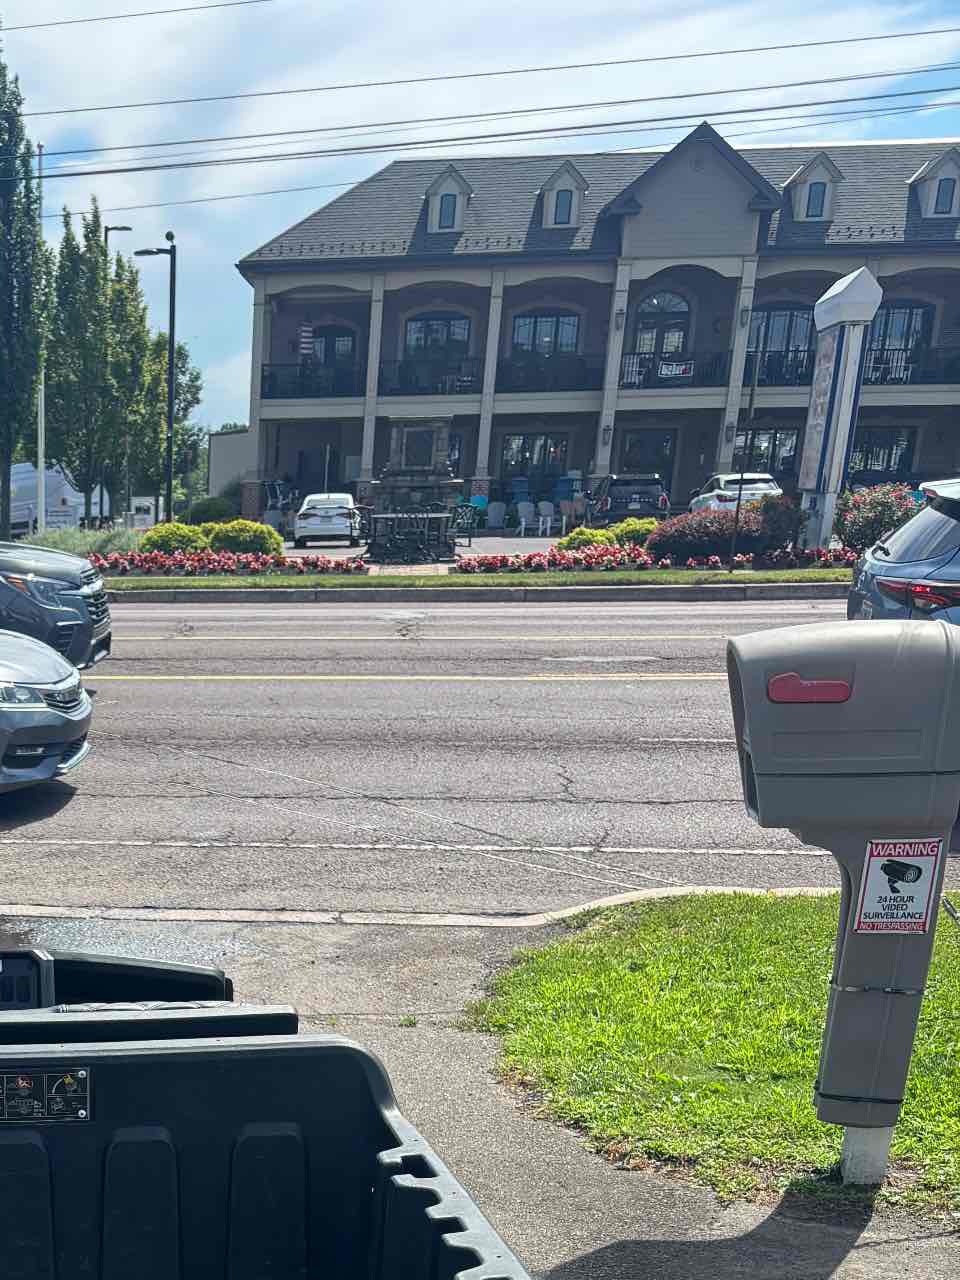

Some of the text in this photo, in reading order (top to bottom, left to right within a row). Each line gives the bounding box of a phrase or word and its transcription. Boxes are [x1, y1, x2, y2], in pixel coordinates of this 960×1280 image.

[872, 843, 938, 856] WARNING
[877, 895, 914, 904] 24 HOUR
[882, 903, 907, 911] VIDEO
[863, 911, 924, 920] SURVEILLANCE
